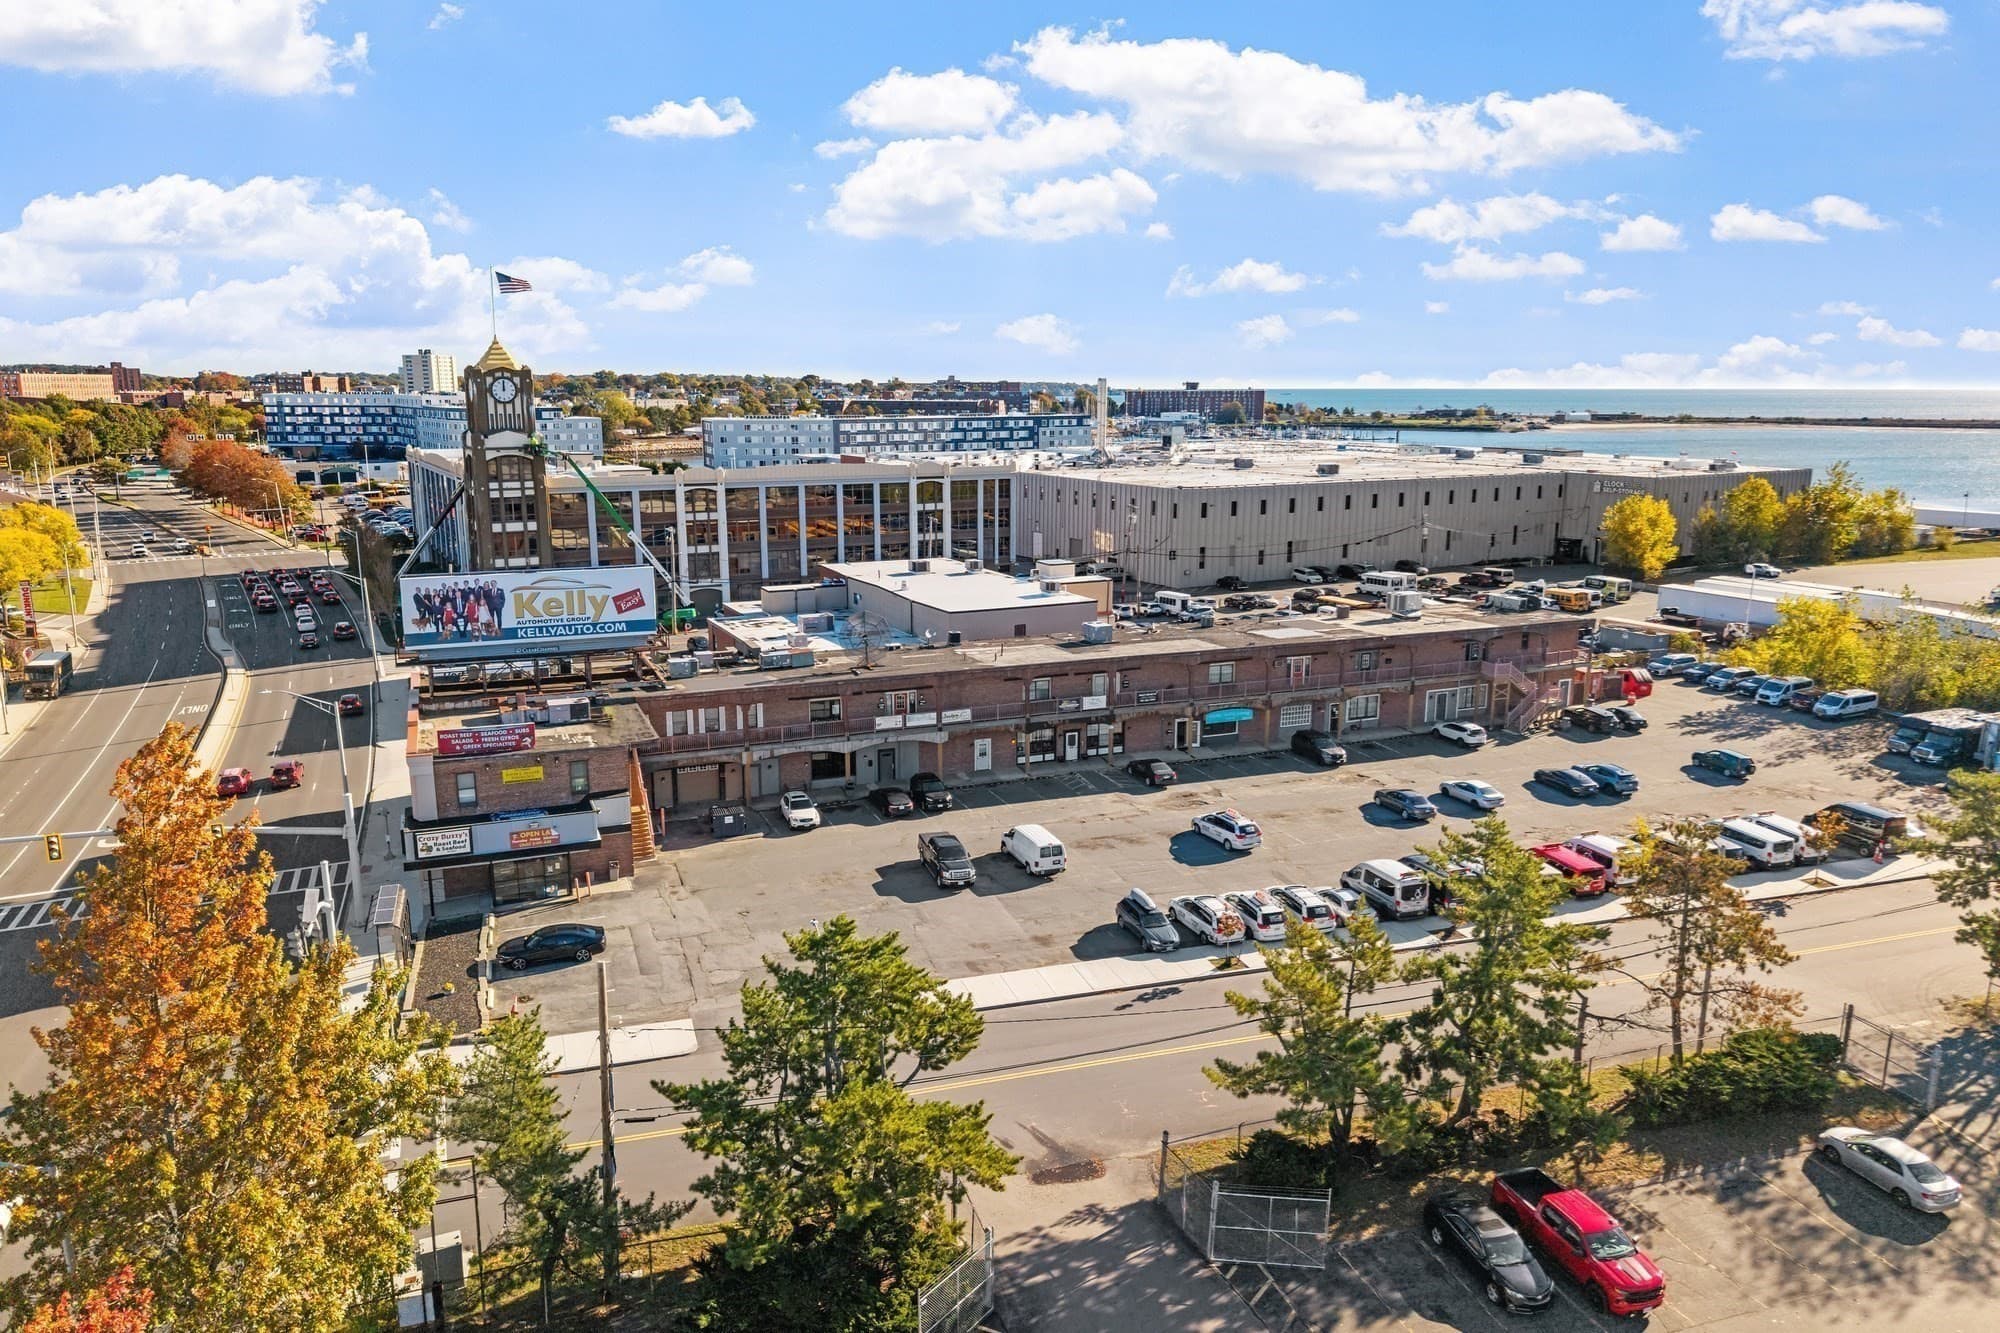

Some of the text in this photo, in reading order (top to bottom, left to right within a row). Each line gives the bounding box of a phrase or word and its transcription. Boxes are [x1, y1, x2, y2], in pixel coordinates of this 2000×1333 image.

[514, 590, 609, 622] Kelly
[516, 617, 565, 626] AUTOMOTIVE
[517, 622, 627, 638] KELLYAUTO.COM
[179, 704, 209, 715] ONLY
[520, 830, 540, 838] OPEN
